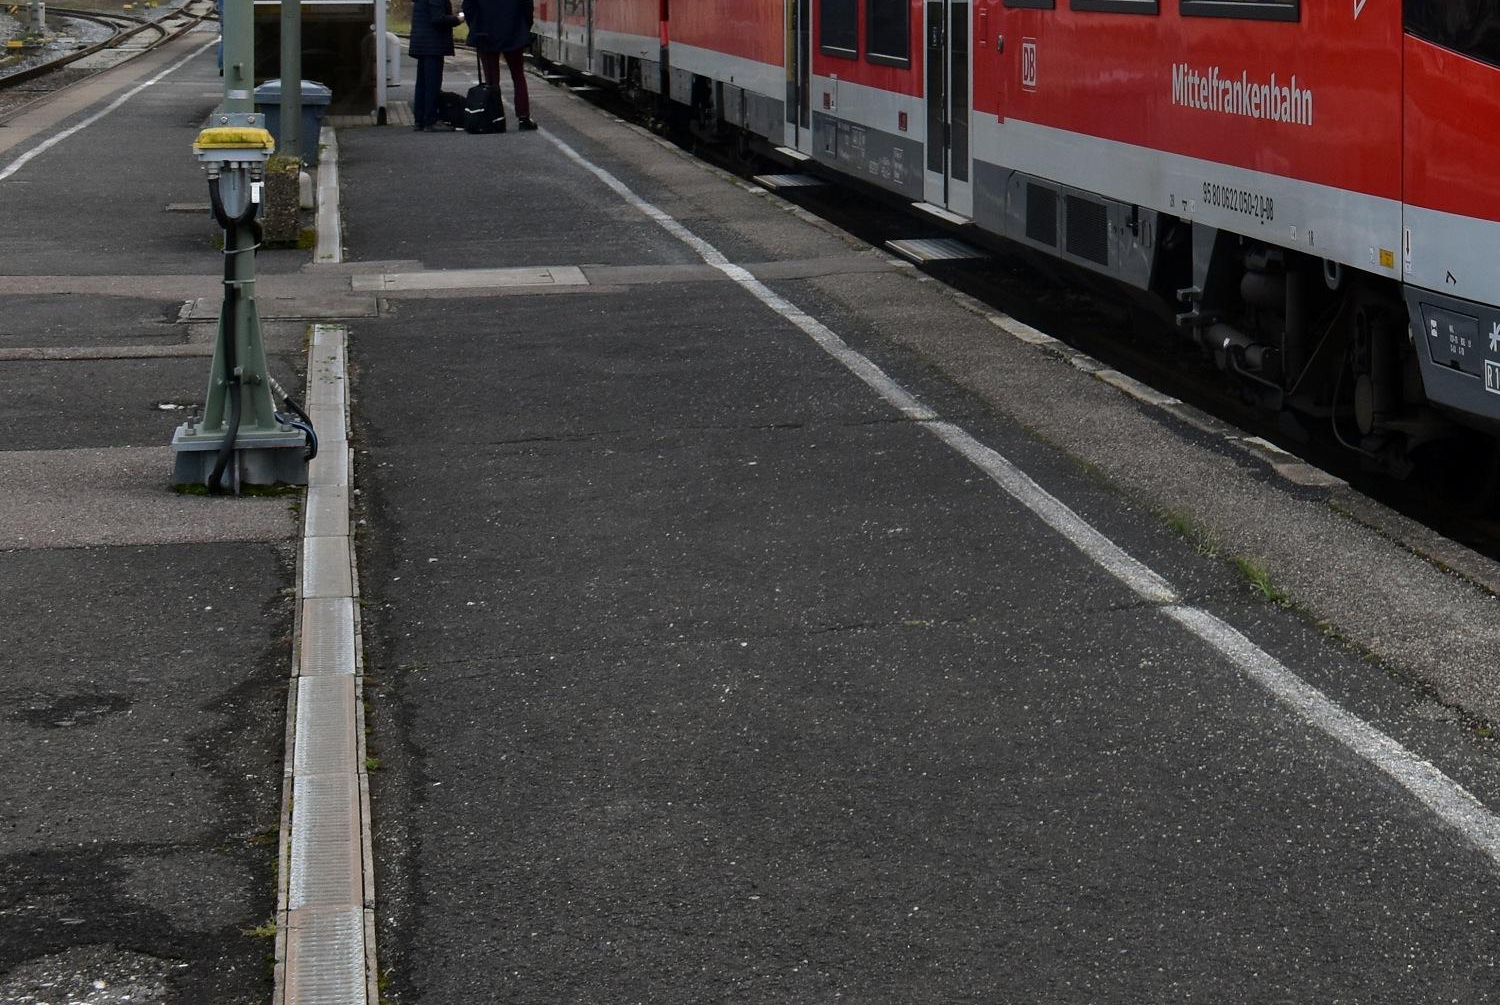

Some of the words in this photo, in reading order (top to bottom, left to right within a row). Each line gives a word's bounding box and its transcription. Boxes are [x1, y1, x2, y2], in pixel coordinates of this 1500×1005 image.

[1023, 44, 1036, 85] DB
[1172, 63, 1313, 126] Mittelfrankenbahn
[1203, 182, 1211, 204] 95
[1212, 184, 1220, 207] 80
[1222, 186, 1238, 211] 0622
[1239, 191, 1258, 217] 050-2
[1487, 365, 1494, 387] R
